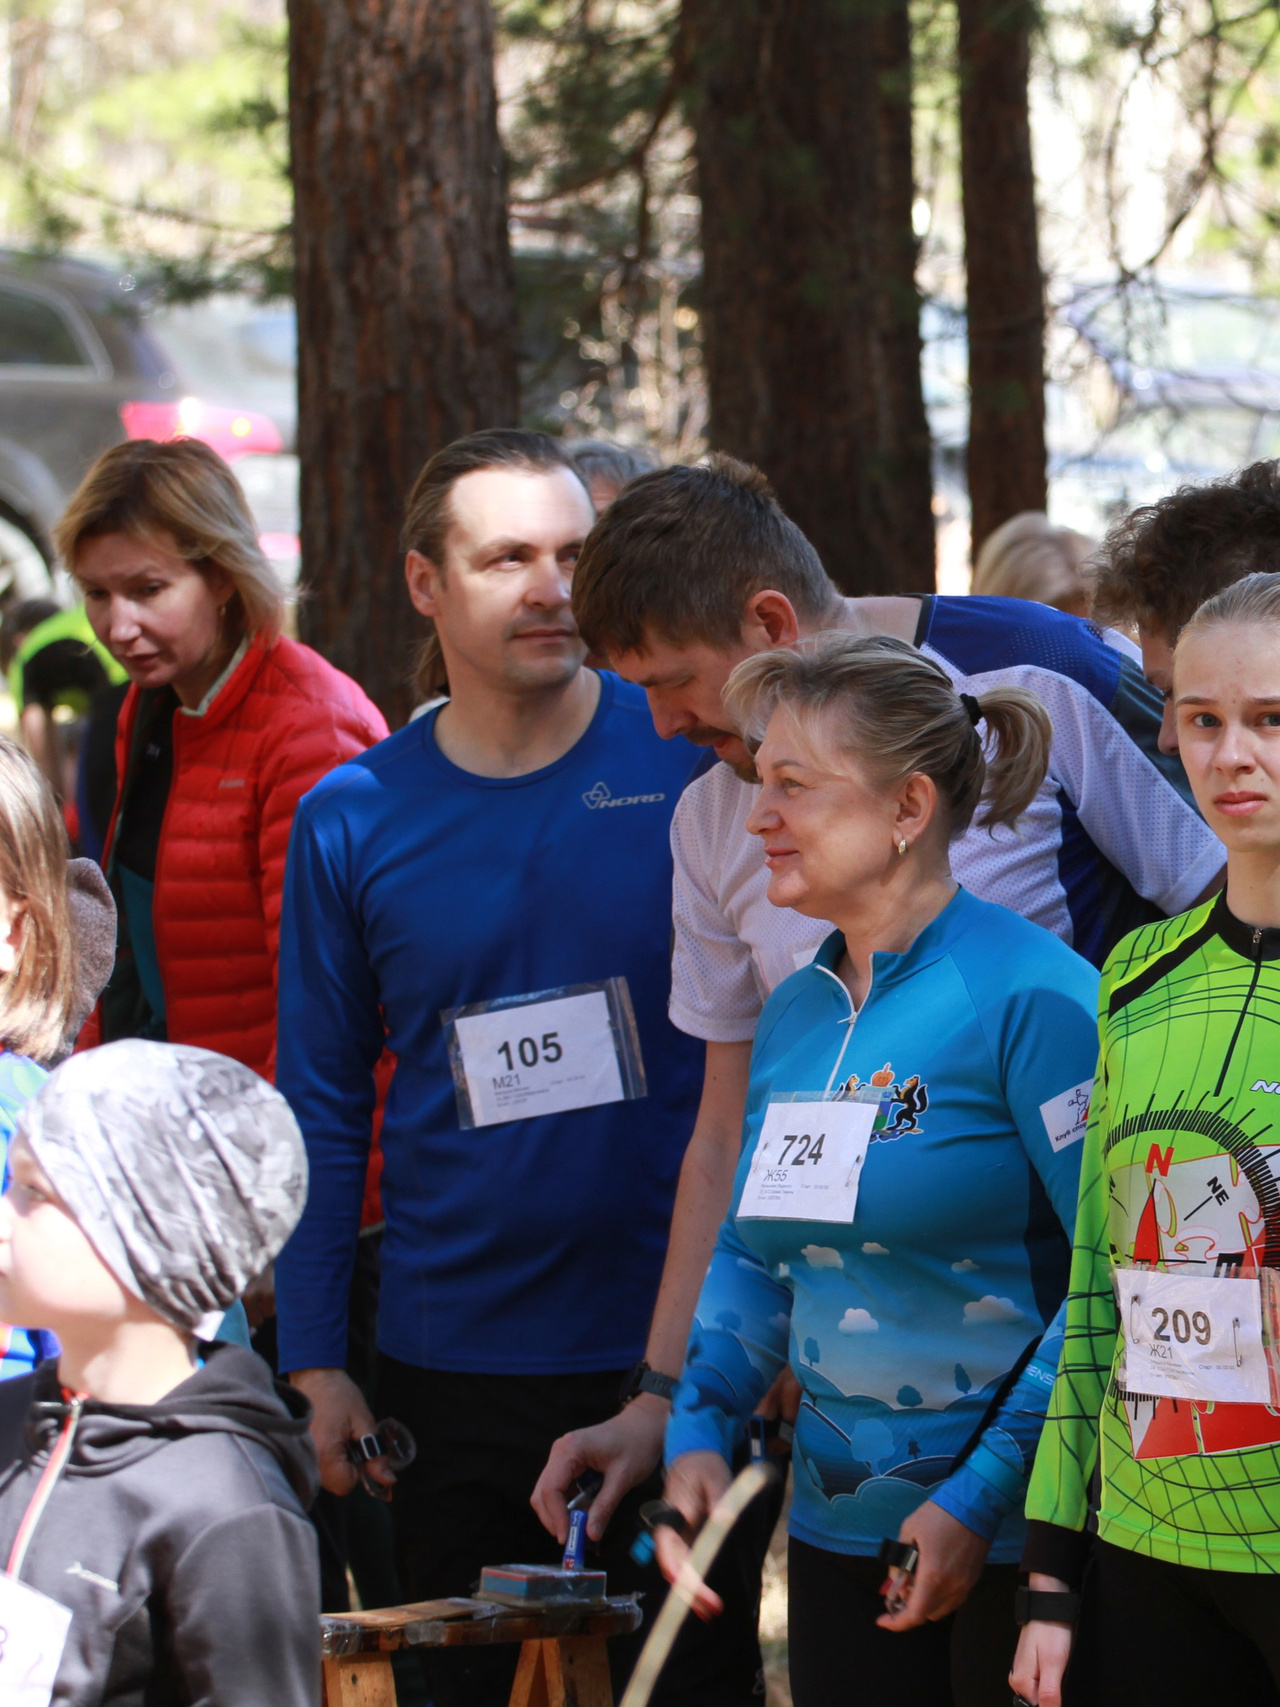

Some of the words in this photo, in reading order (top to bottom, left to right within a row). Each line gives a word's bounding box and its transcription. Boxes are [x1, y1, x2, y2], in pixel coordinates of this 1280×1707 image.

[599, 793, 666, 808] NORD
[497, 1031, 563, 1071] 105
[777, 1133, 826, 1166] 724
[1145, 1142, 1175, 1177] N
[763, 1169, 789, 1182] Ж55
[1206, 1175, 1230, 1206] NE
[1151, 1307, 1212, 1346] 209
[1149, 1343, 1173, 1359] Ж21
